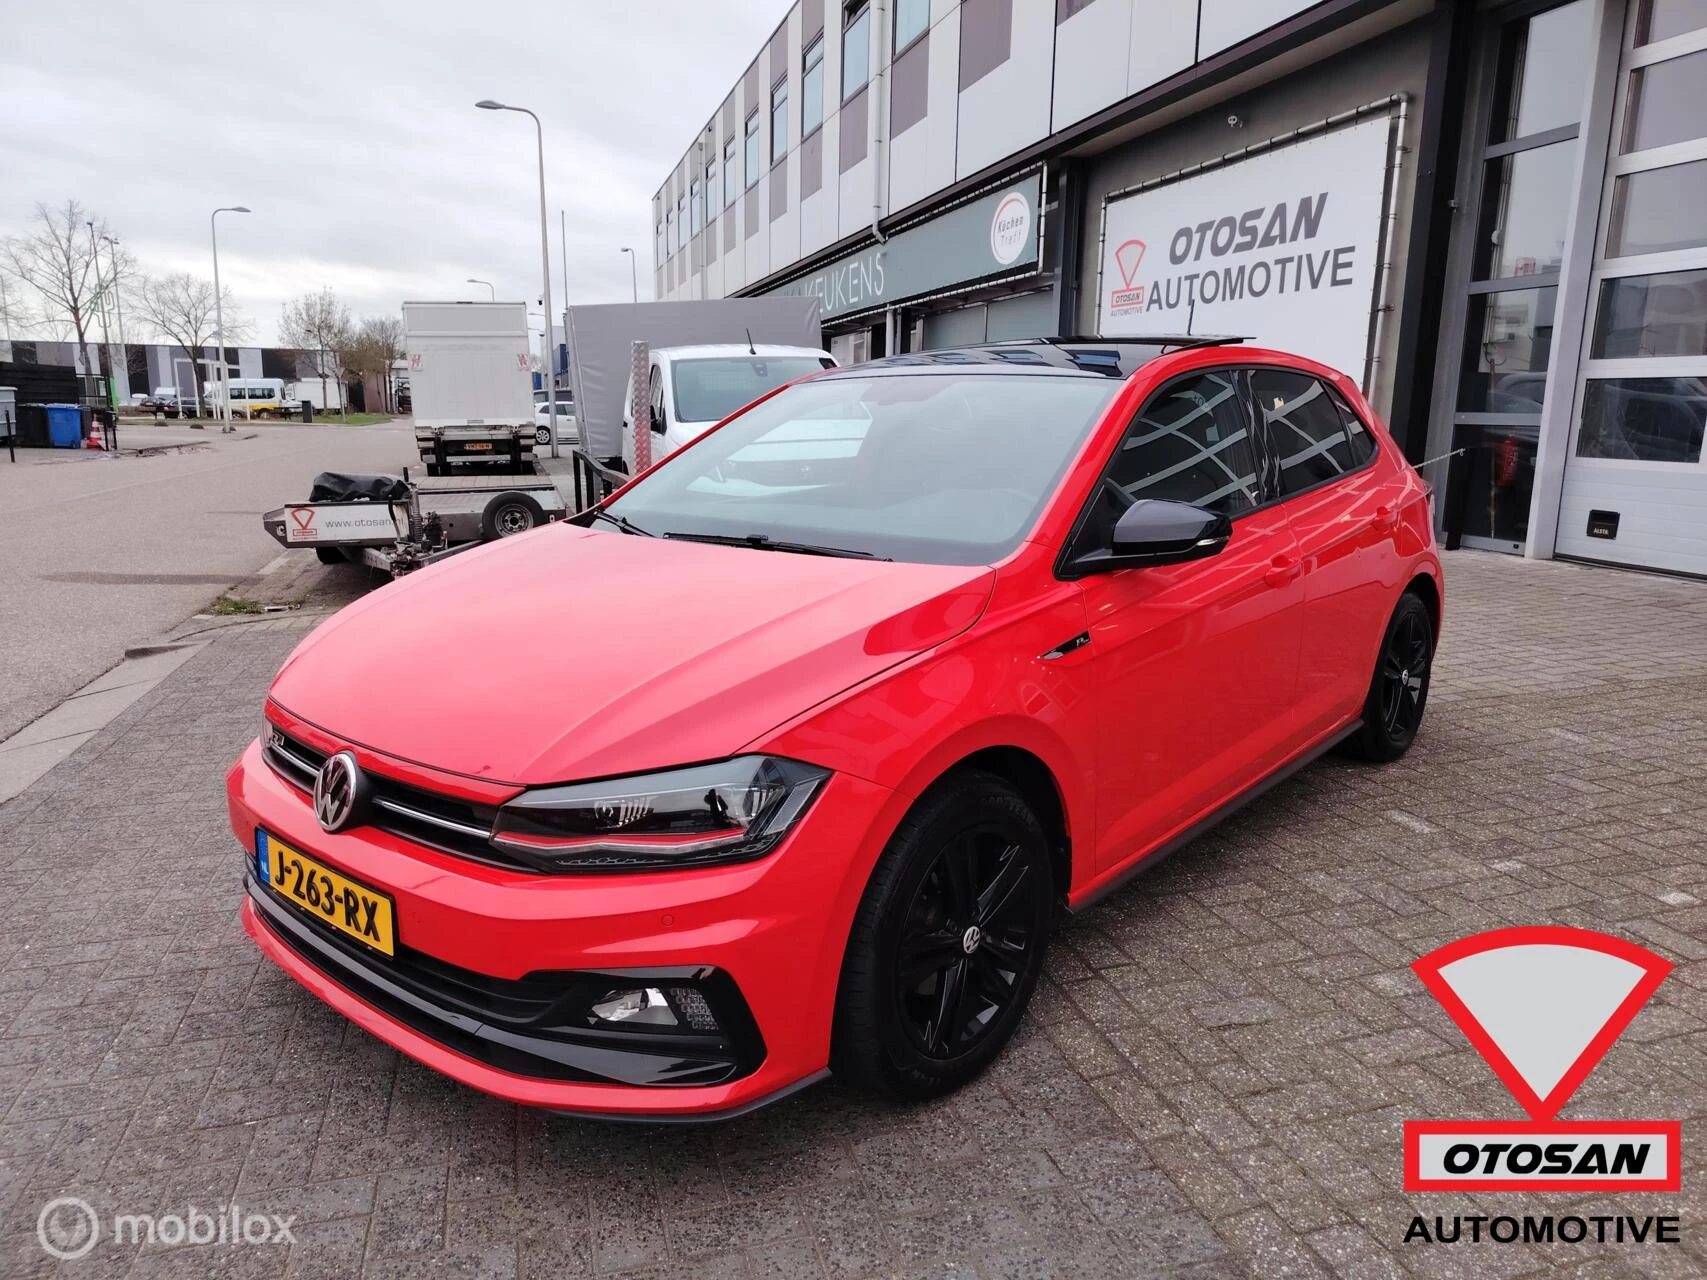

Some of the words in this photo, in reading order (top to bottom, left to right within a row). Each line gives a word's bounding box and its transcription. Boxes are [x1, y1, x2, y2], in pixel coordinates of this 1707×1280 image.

[1169, 192, 1329, 265] OTOSAN
[1115, 291, 1141, 304] OTOSAN
[1146, 245, 1356, 313] AUTOMOTIVE
[275, 850, 380, 942] J-263-RX
